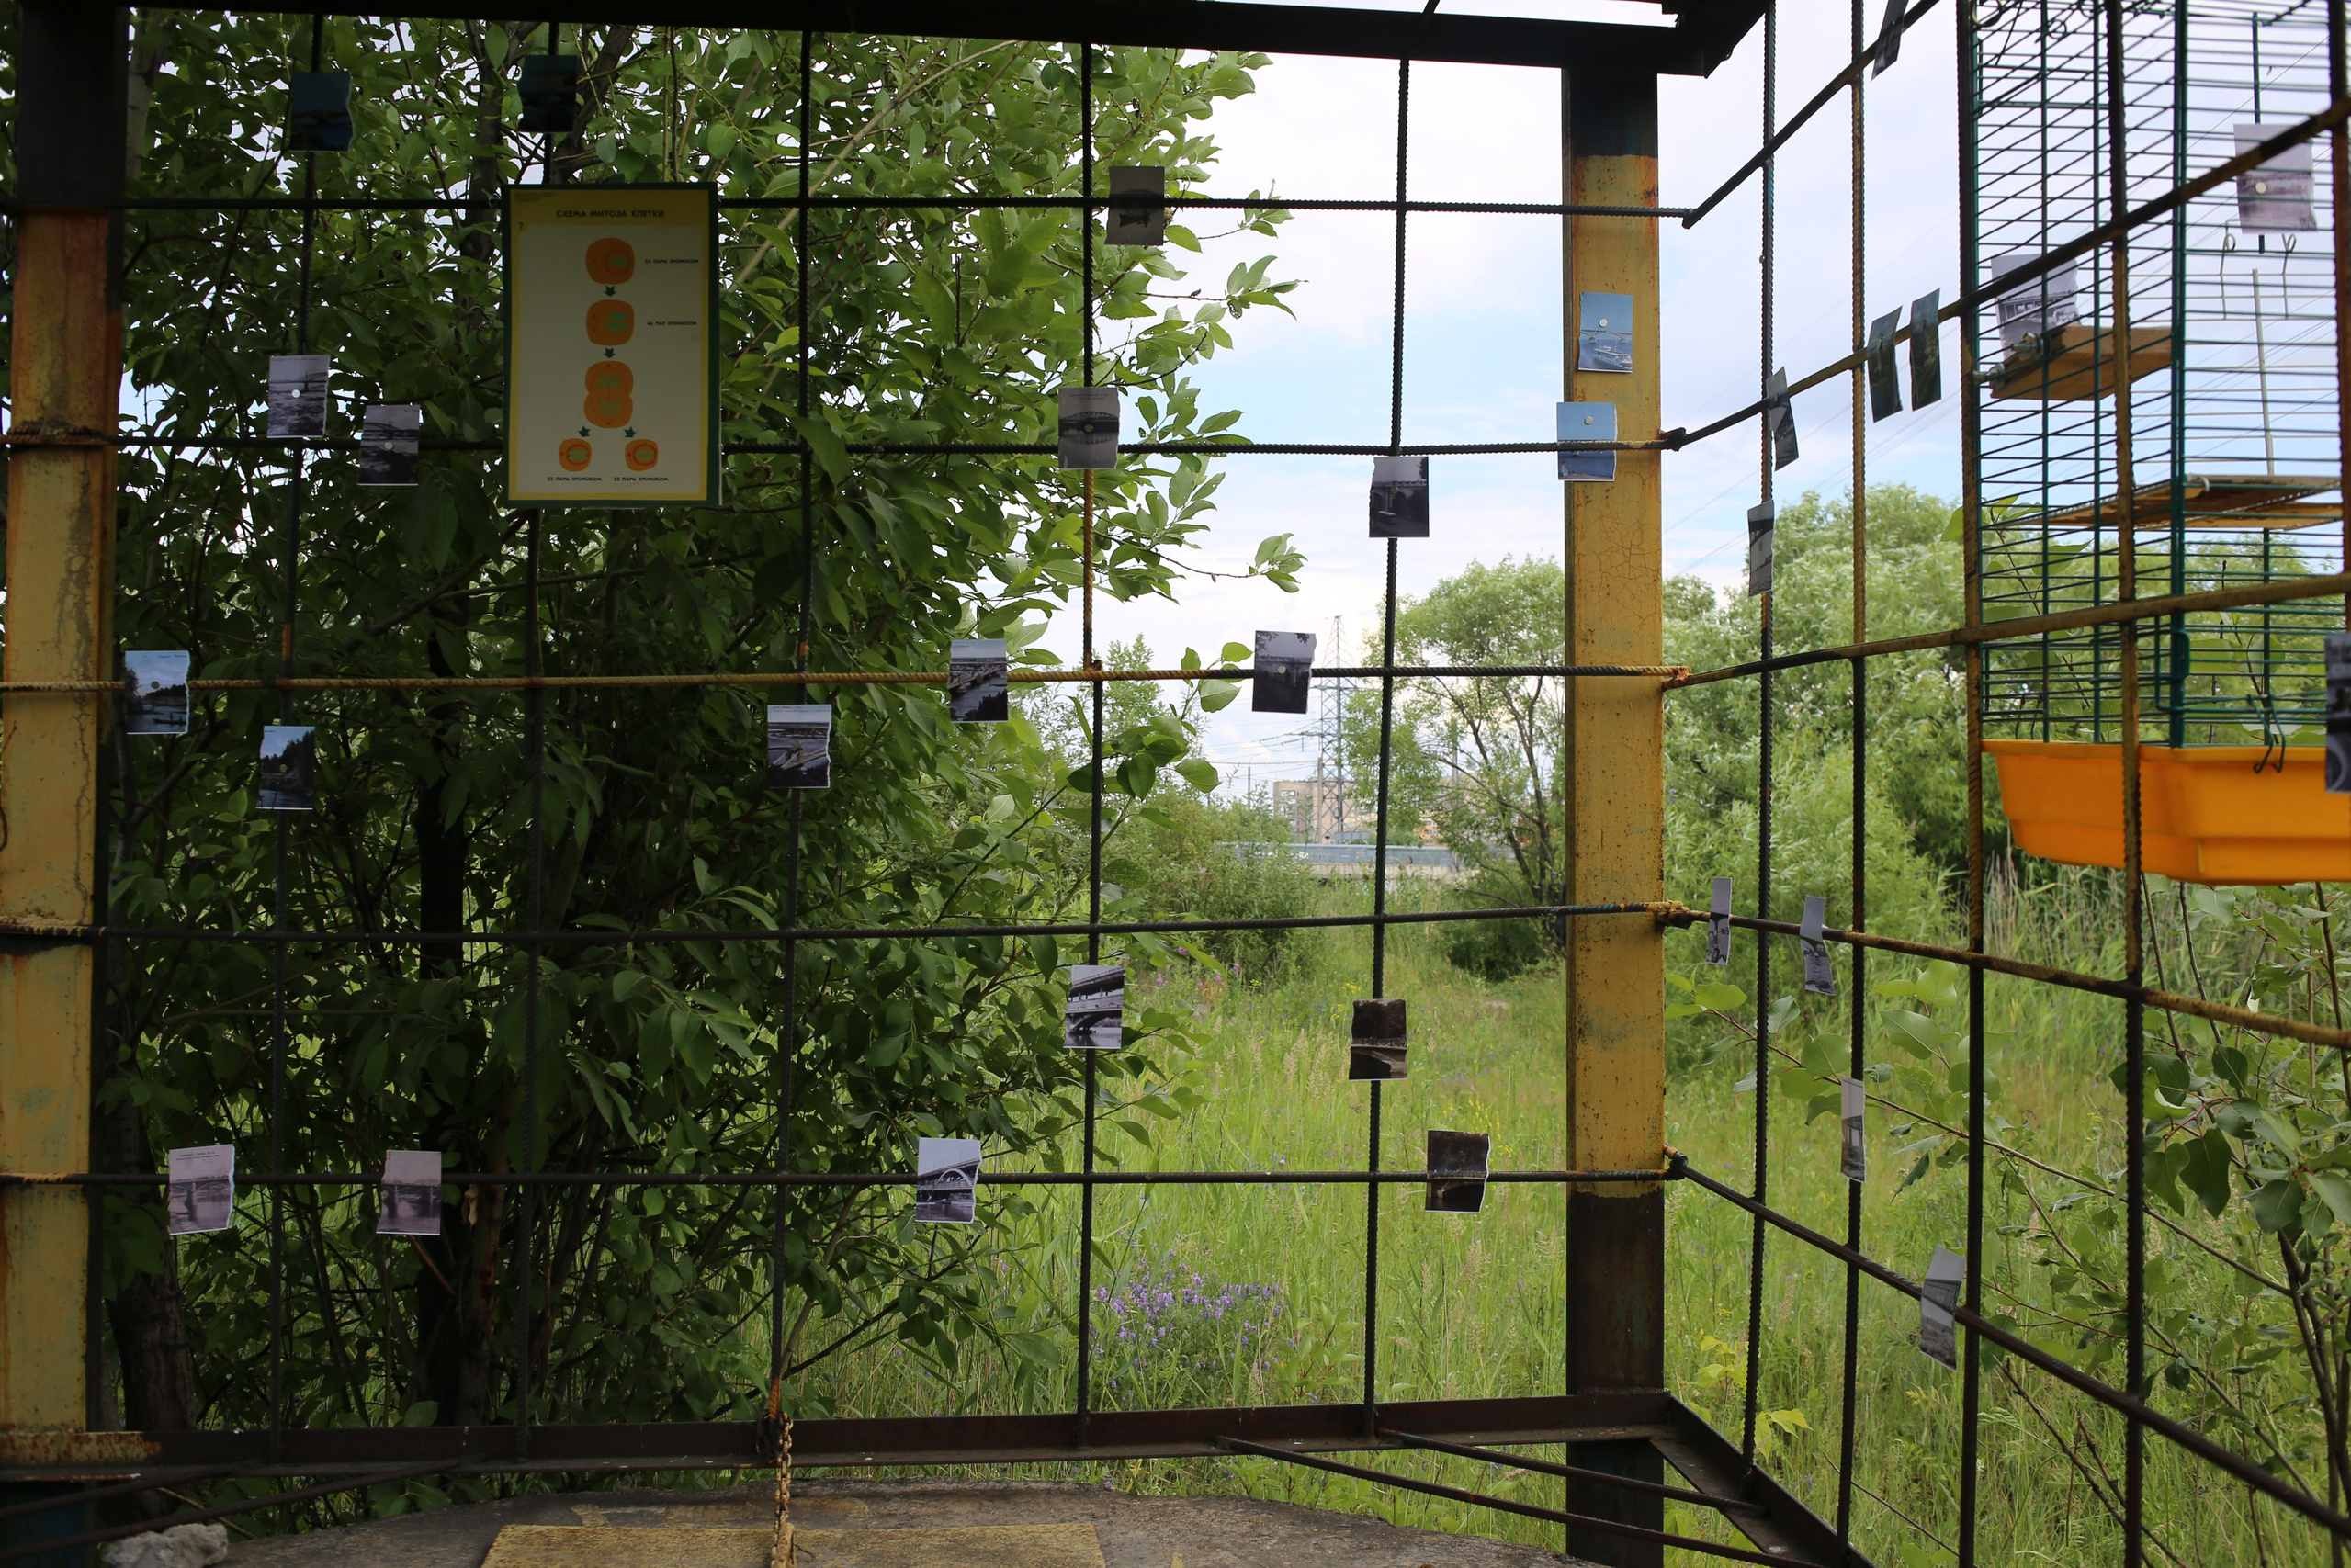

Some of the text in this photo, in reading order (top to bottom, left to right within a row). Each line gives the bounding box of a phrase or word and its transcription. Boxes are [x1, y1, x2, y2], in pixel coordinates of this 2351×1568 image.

[555, 209, 664, 218] СХЕМА МИТОЗА КЛЕТКИ
